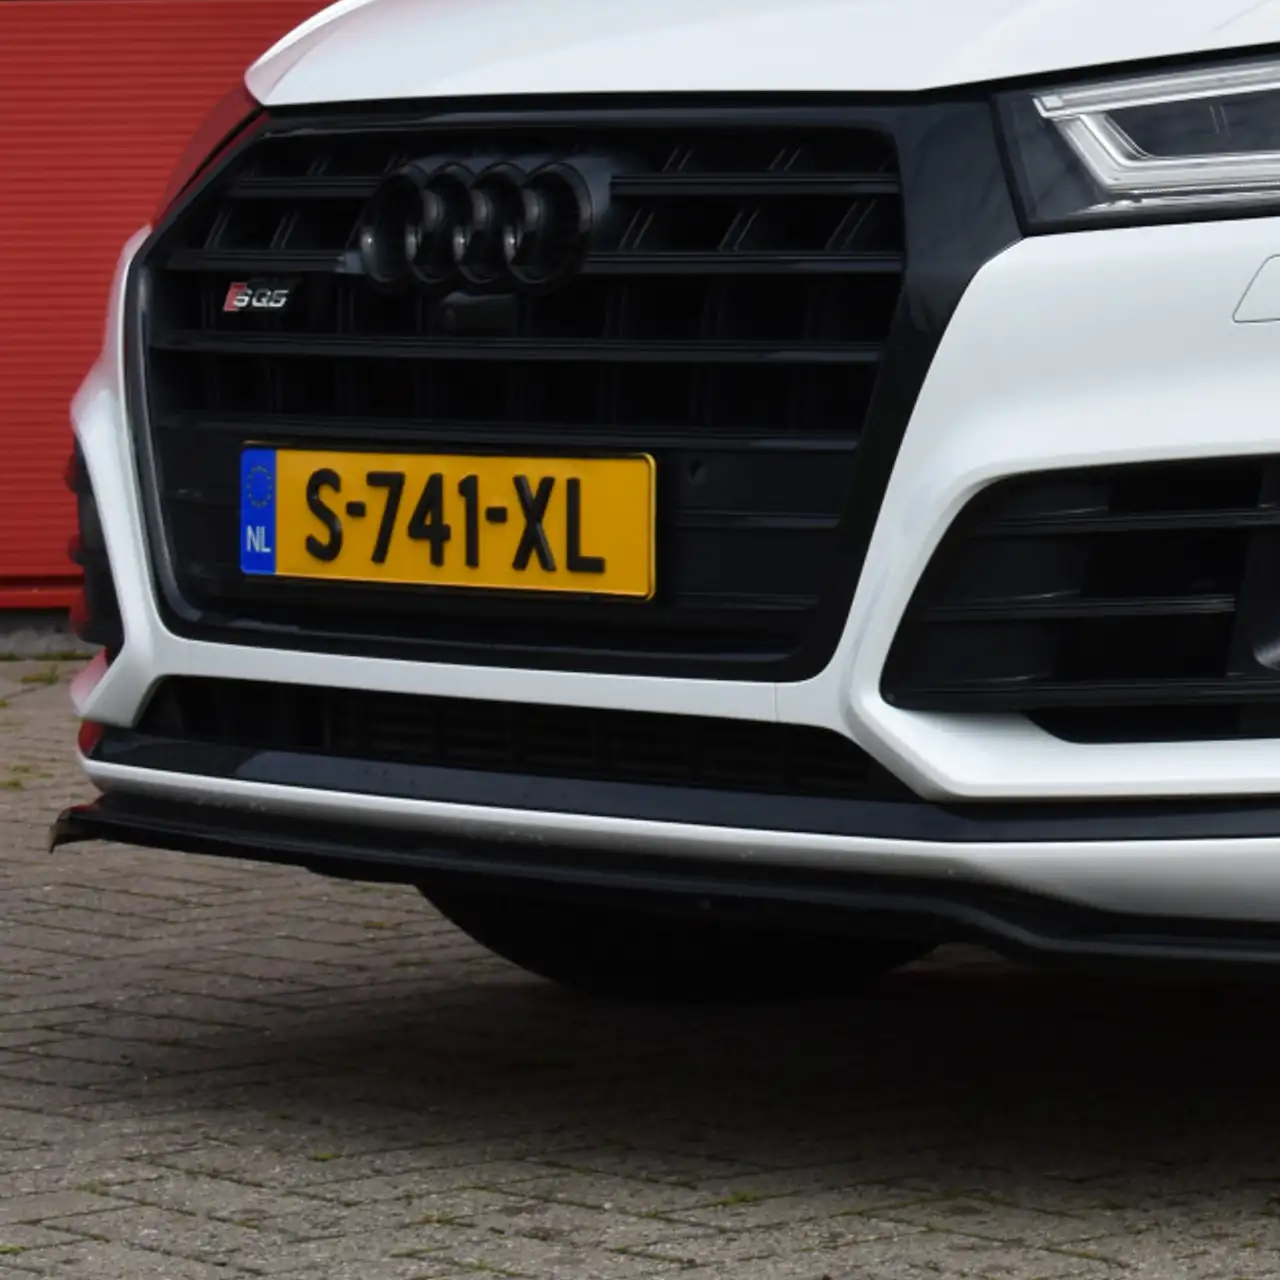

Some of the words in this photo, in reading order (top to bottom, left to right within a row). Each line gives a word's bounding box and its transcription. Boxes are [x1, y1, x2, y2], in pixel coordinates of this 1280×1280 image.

[228, 286, 289, 309] SQ5
[305, 467, 606, 574] S-741-XL
[246, 525, 271, 553] NL
